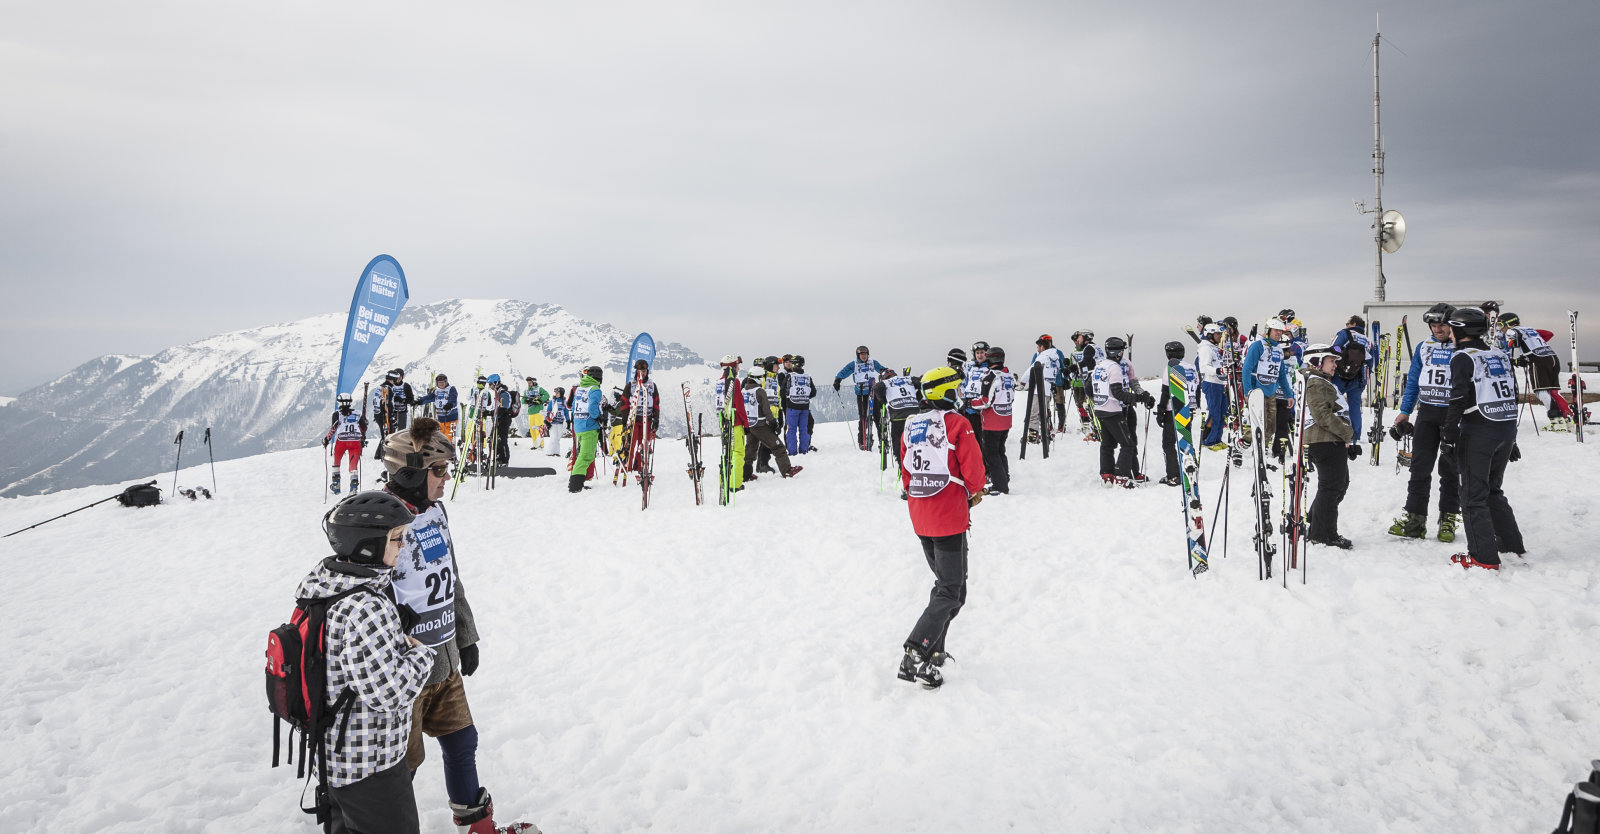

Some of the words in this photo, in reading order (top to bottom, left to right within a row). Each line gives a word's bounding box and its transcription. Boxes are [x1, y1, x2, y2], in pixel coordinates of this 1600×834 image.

[372, 274, 397, 289] Bezirks
[371, 284, 395, 298] Blätter
[358, 305, 373, 320] Bei
[373, 312, 390, 326] uns
[355, 316, 368, 331] ist
[368, 322, 386, 337] was
[353, 328, 371, 344] los!
[922, 476, 945, 487] Race
[416, 527, 440, 541] Bezirks
[421, 536, 443, 551] Blätter
[425, 566, 454, 606] 22
